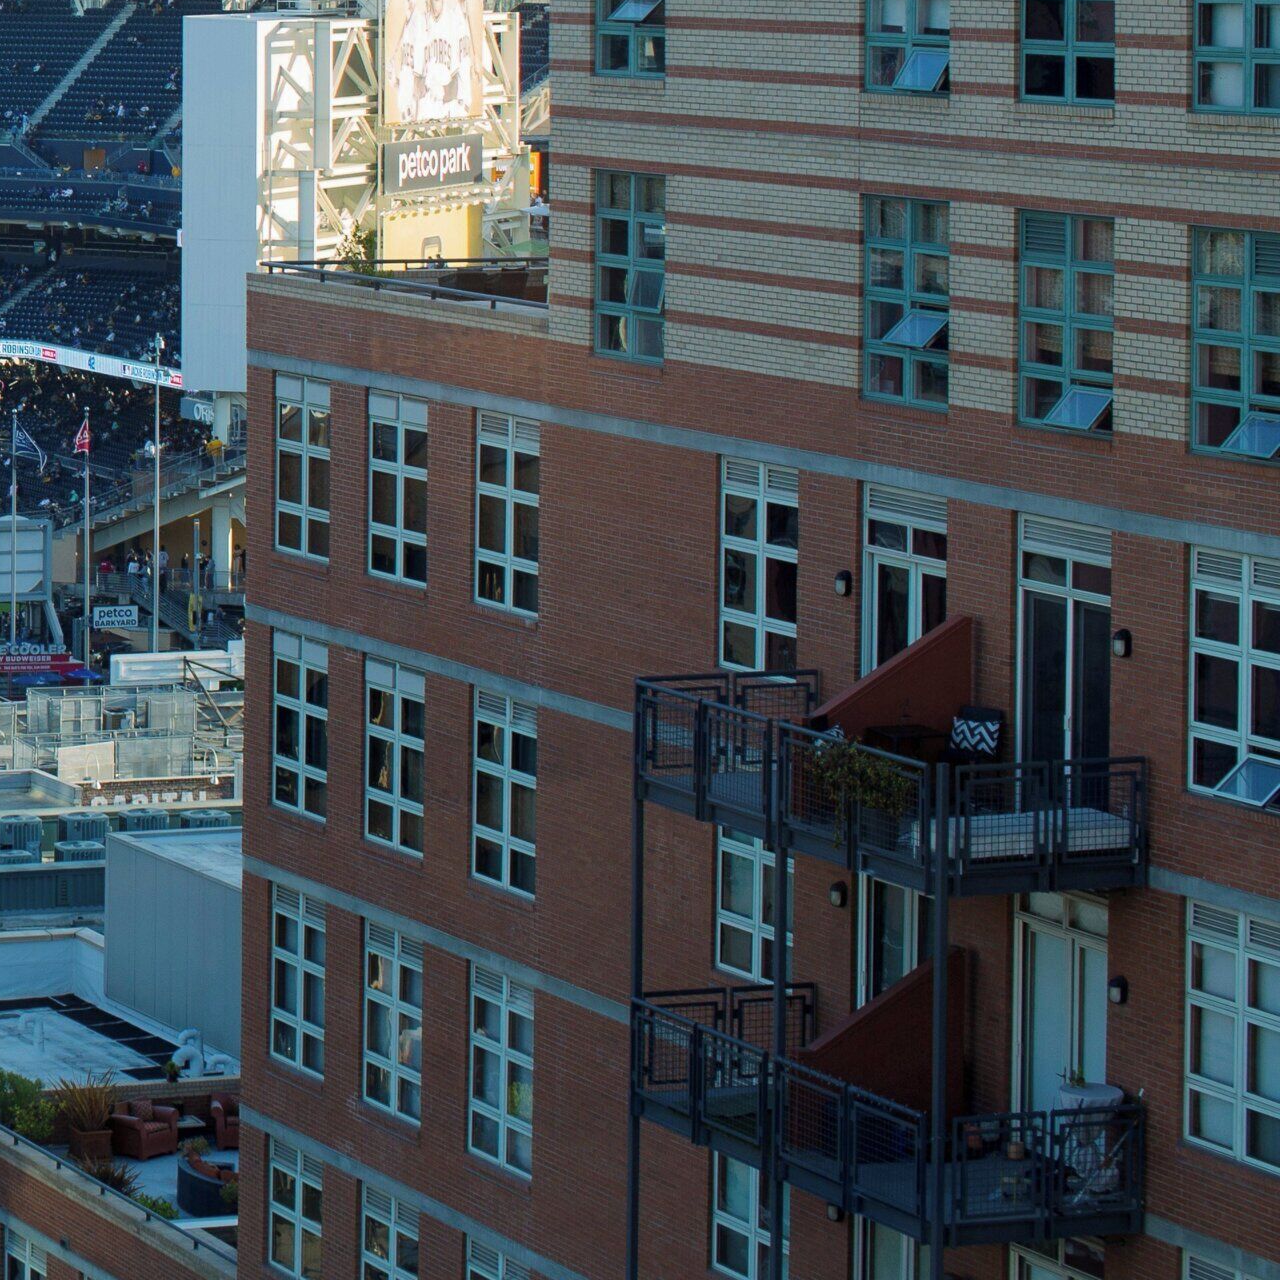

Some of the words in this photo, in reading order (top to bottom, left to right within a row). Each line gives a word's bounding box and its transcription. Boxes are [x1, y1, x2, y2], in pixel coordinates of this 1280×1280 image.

[398, 145, 438, 187] petco
[440, 142, 471, 181] park
[98, 607, 132, 620] petco
[94, 619, 137, 627] BARKYARD
[9, 643, 67, 656] COOLER
